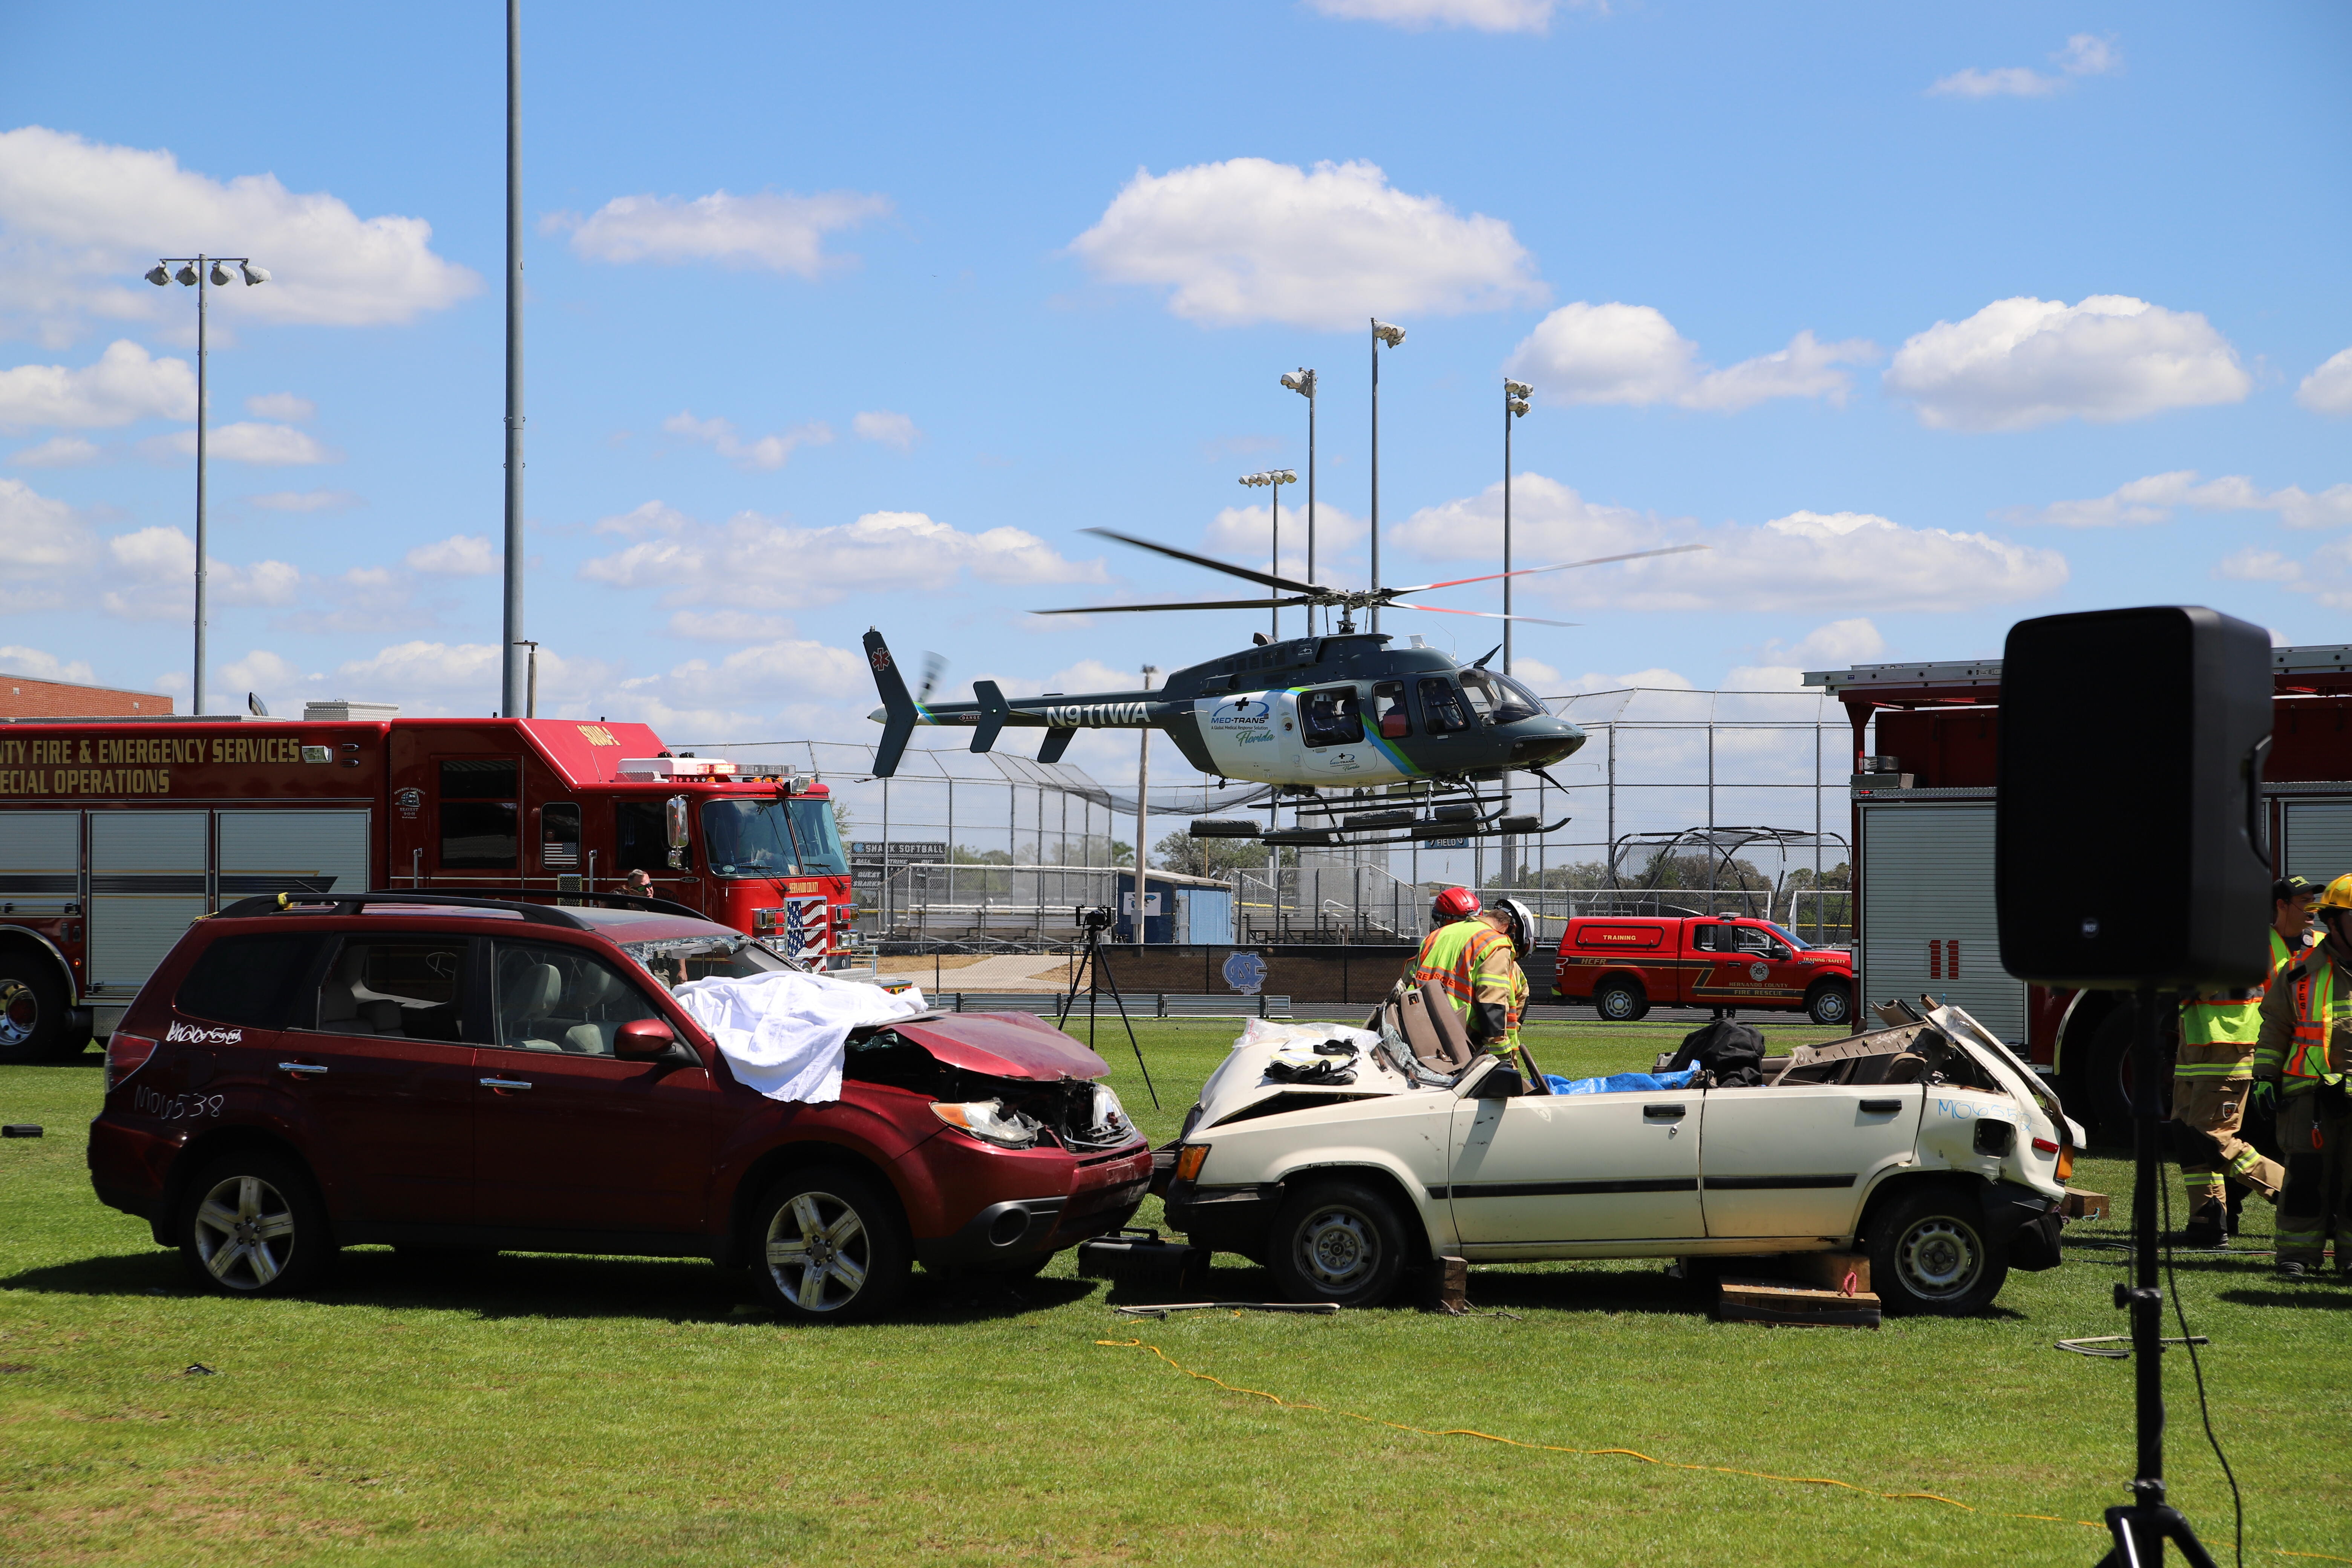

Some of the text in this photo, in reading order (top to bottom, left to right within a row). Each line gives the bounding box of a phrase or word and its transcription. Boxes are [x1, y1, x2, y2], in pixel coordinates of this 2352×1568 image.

[1046, 701, 1152, 727] N911WA
[1236, 730, 1275, 747] Florida
[33, 740, 72, 764] FIRE
[79, 740, 92, 764] &
[99, 739, 207, 763] EMERGENCY
[213, 738, 300, 763] SERVICES
[54, 769, 170, 793] OPERATIONS
[866, 844, 944, 853] SHAK SOFTBALL
[789, 882, 819, 893] HERNANDO COUNTY
[1928, 940, 1959, 980] 11
